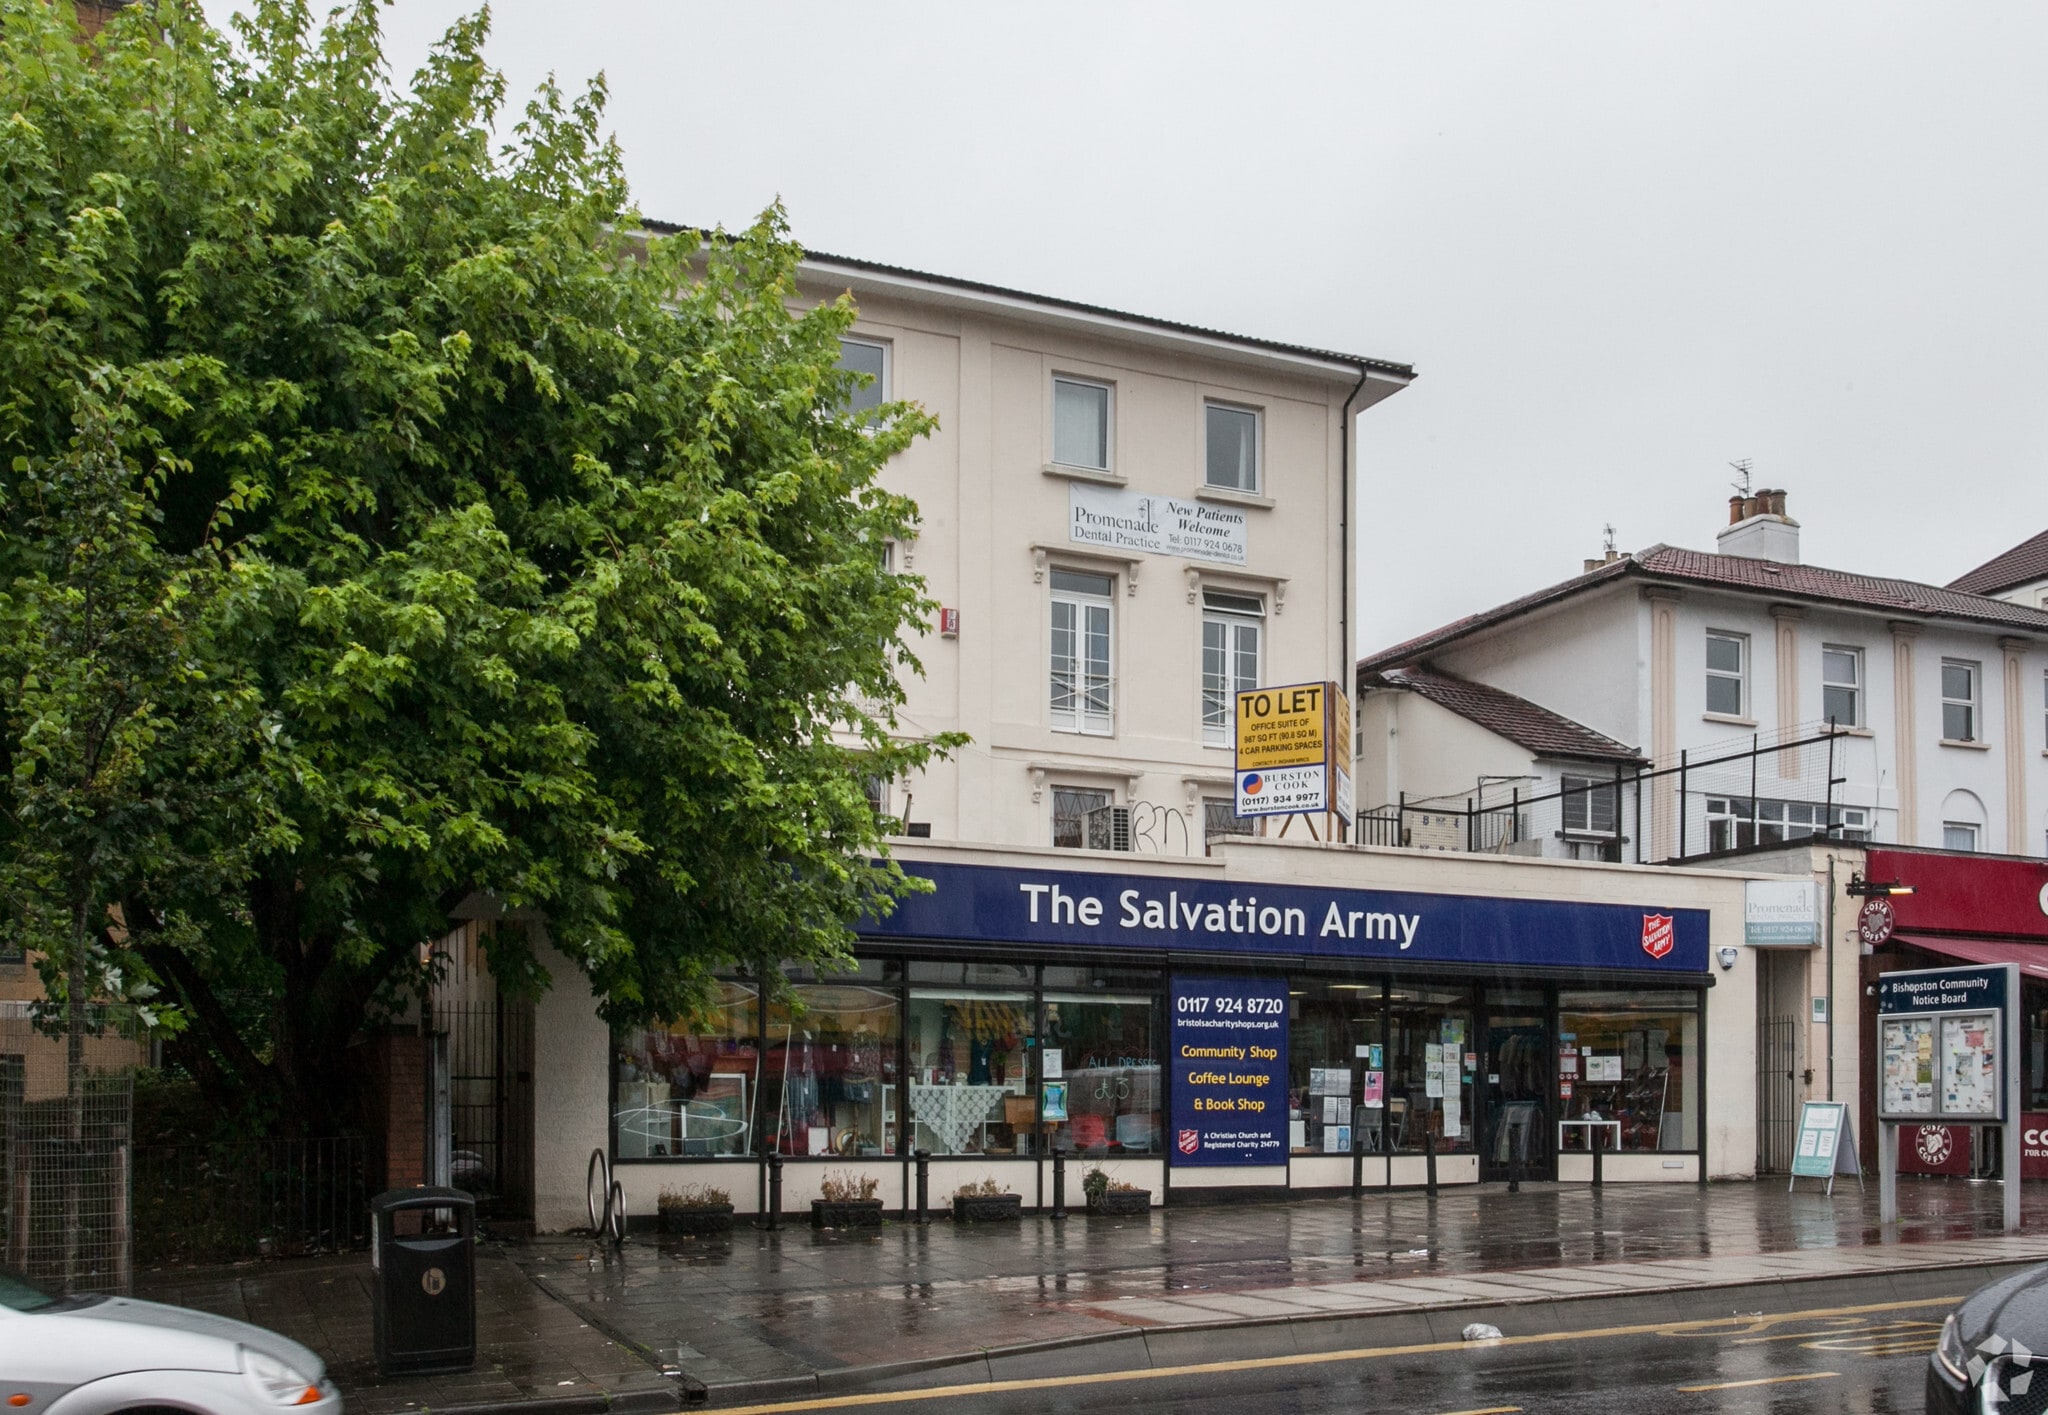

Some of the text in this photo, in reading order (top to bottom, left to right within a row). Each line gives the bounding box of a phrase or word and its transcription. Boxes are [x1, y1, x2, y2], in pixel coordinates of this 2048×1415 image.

[1075, 499, 1159, 534] Promenade
[1166, 501, 1193, 516] New
[1196, 506, 1244, 525] Patients
[1178, 518, 1231, 538] Welcome
[1075, 525, 1161, 549] Dental Practice
[1184, 536, 1202, 547] 0117
[1203, 539, 1220, 550] 924
[1222, 542, 1243, 554] 0678
[1241, 688, 1321, 718] TO LET
[1251, 718, 1310, 731] OFFICE SUITE OF
[1257, 733, 1268, 743] SQ
[1269, 732, 1278, 740] FT
[1297, 729, 1307, 739] SQ
[1308, 728, 1318, 738] M)
[1245, 746, 1260, 755] CAR
[1261, 743, 1293, 754] PARKING
[1294, 740, 1323, 750] SPACES
[1264, 770, 1320, 783] BURSTON
[1274, 781, 1309, 791] COOK
[1242, 792, 1320, 807] (0117) 934 9977
[1242, 802, 1320, 813] www.burstoncook.co.uk
[1748, 889, 1813, 914] Promenade
[1864, 902, 1888, 915] COSTA
[1020, 883, 1420, 950] The Salvation Army
[1861, 926, 1889, 941] COFFEE
[1892, 977, 1989, 993] Bishopston Community
[1178, 996, 1284, 1014] 0117 924 8720
[1912, 992, 1967, 1006] Notice Board
[1177, 1018, 1279, 1030] bristolsacharityshops.org.uk
[1181, 1045, 1278, 1061] Community Shop
[1089, 1056, 1109, 1069] ALL
[1188, 1071, 1270, 1087] Coffee Lounge
[1194, 1098, 1265, 1112] & Book Shop
[1204, 1141, 1235, 1149] Registered
[1236, 1141, 1259, 1149] Charity
[1919, 1146, 1949, 1163] COFFEE
[2024, 1149, 2040, 1157] FOR
